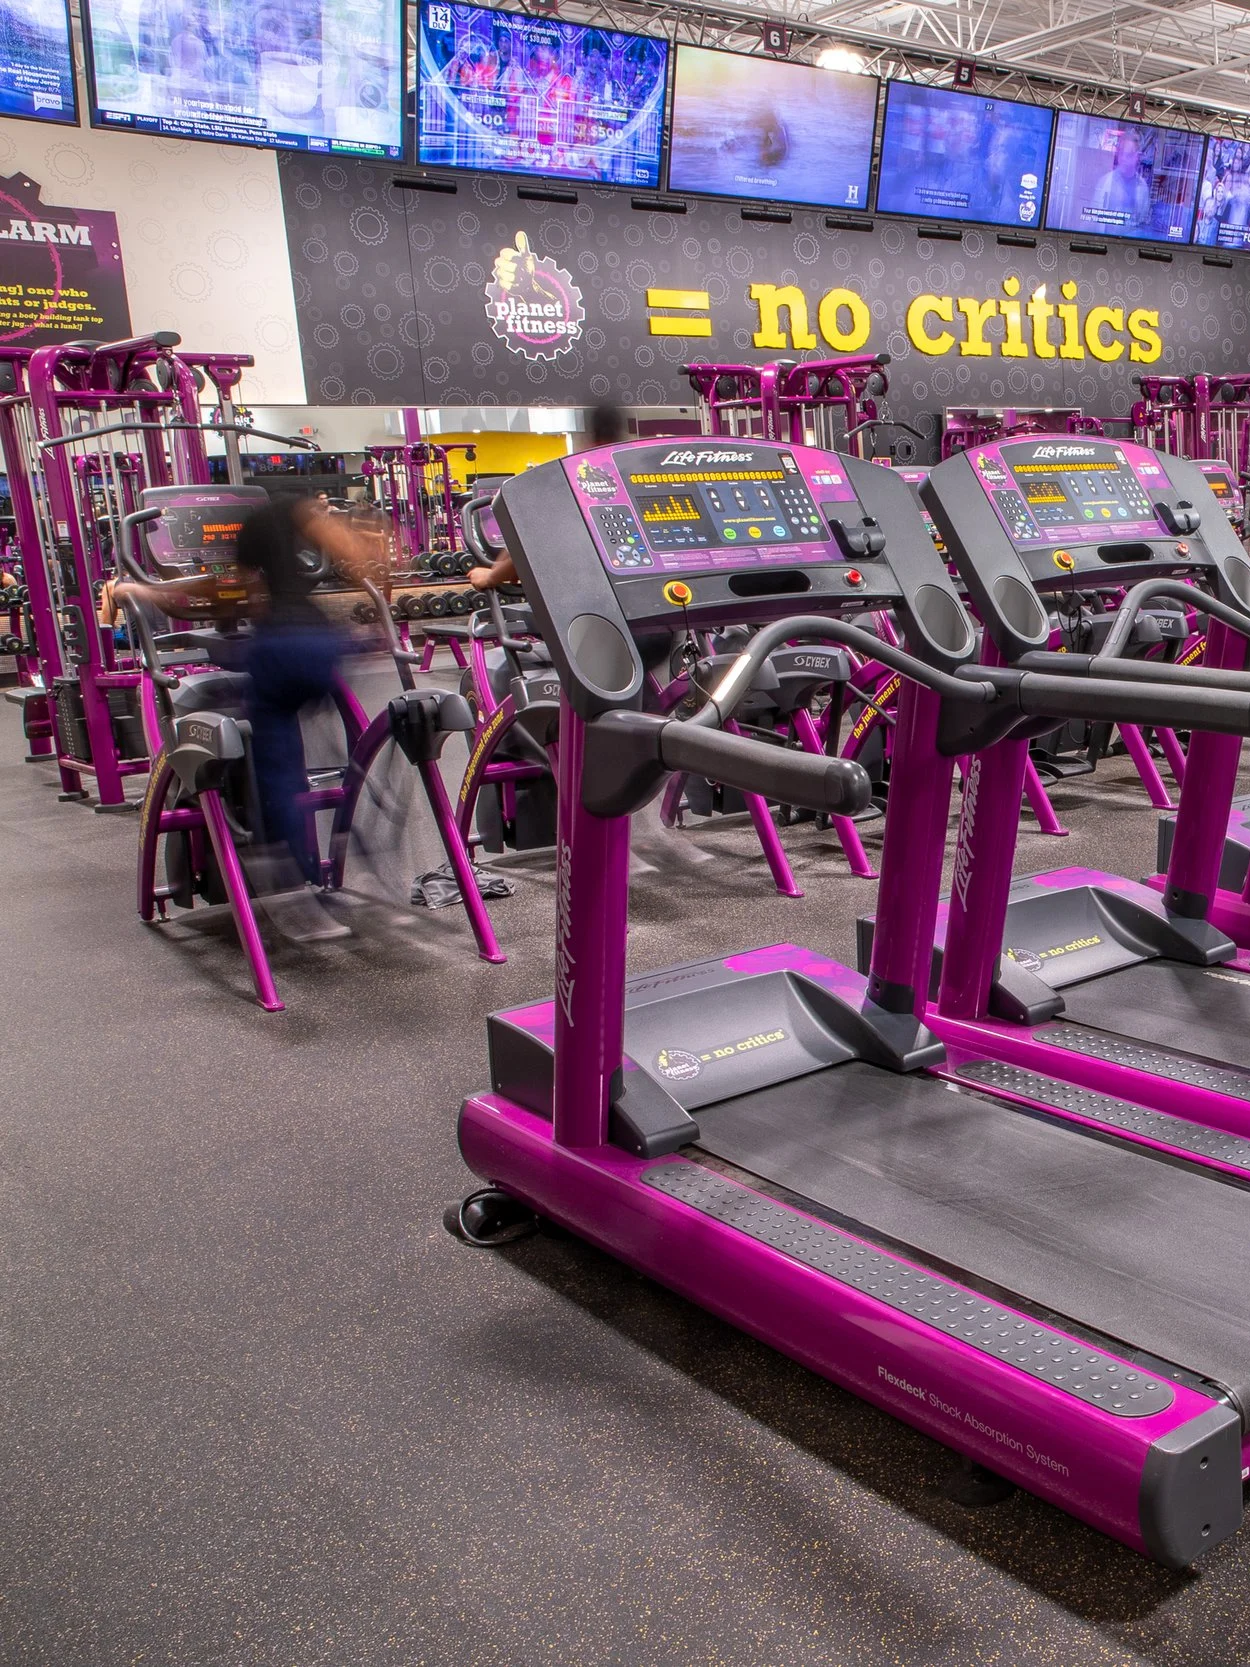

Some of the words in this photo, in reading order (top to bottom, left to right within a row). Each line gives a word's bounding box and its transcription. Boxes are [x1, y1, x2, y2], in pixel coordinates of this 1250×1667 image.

[432, 12, 448, 24] 14
[432, 22, 447, 30] DLV
[770, 30, 781, 47] 6
[961, 67, 970, 82] 5
[36, 96, 60, 105] bravo
[1134, 100, 1142, 114] 4
[590, 126, 624, 139] $500
[0, 285, 23, 297] ng]
[26, 288, 55, 296] one
[58, 288, 89, 298] who
[24, 300, 41, 308] or
[43, 299, 97, 312] judges.
[495, 298, 563, 321] planet
[19, 312, 38, 320] body
[40, 313, 72, 323] building
[91, 316, 104, 324] top
[506, 315, 578, 334] fitness
[750, 283, 871, 352] no
[905, 275, 1163, 363] critics
[581, 480, 608, 490] planet
[805, 656, 831, 669] CYBEX
[862, 685, 895, 728] judgment
[464, 739, 486, 790] judgement
[1048, 944, 1065, 958] no
[1065, 936, 1100, 953] critics
[713, 1046, 735, 1058] no
[737, 1030, 785, 1051] critics
[878, 1365, 926, 1401] Flexdeck
[928, 1393, 962, 1421] Shock
[964, 1412, 1024, 1454] Absorption
[1026, 1444, 1070, 1478] System
